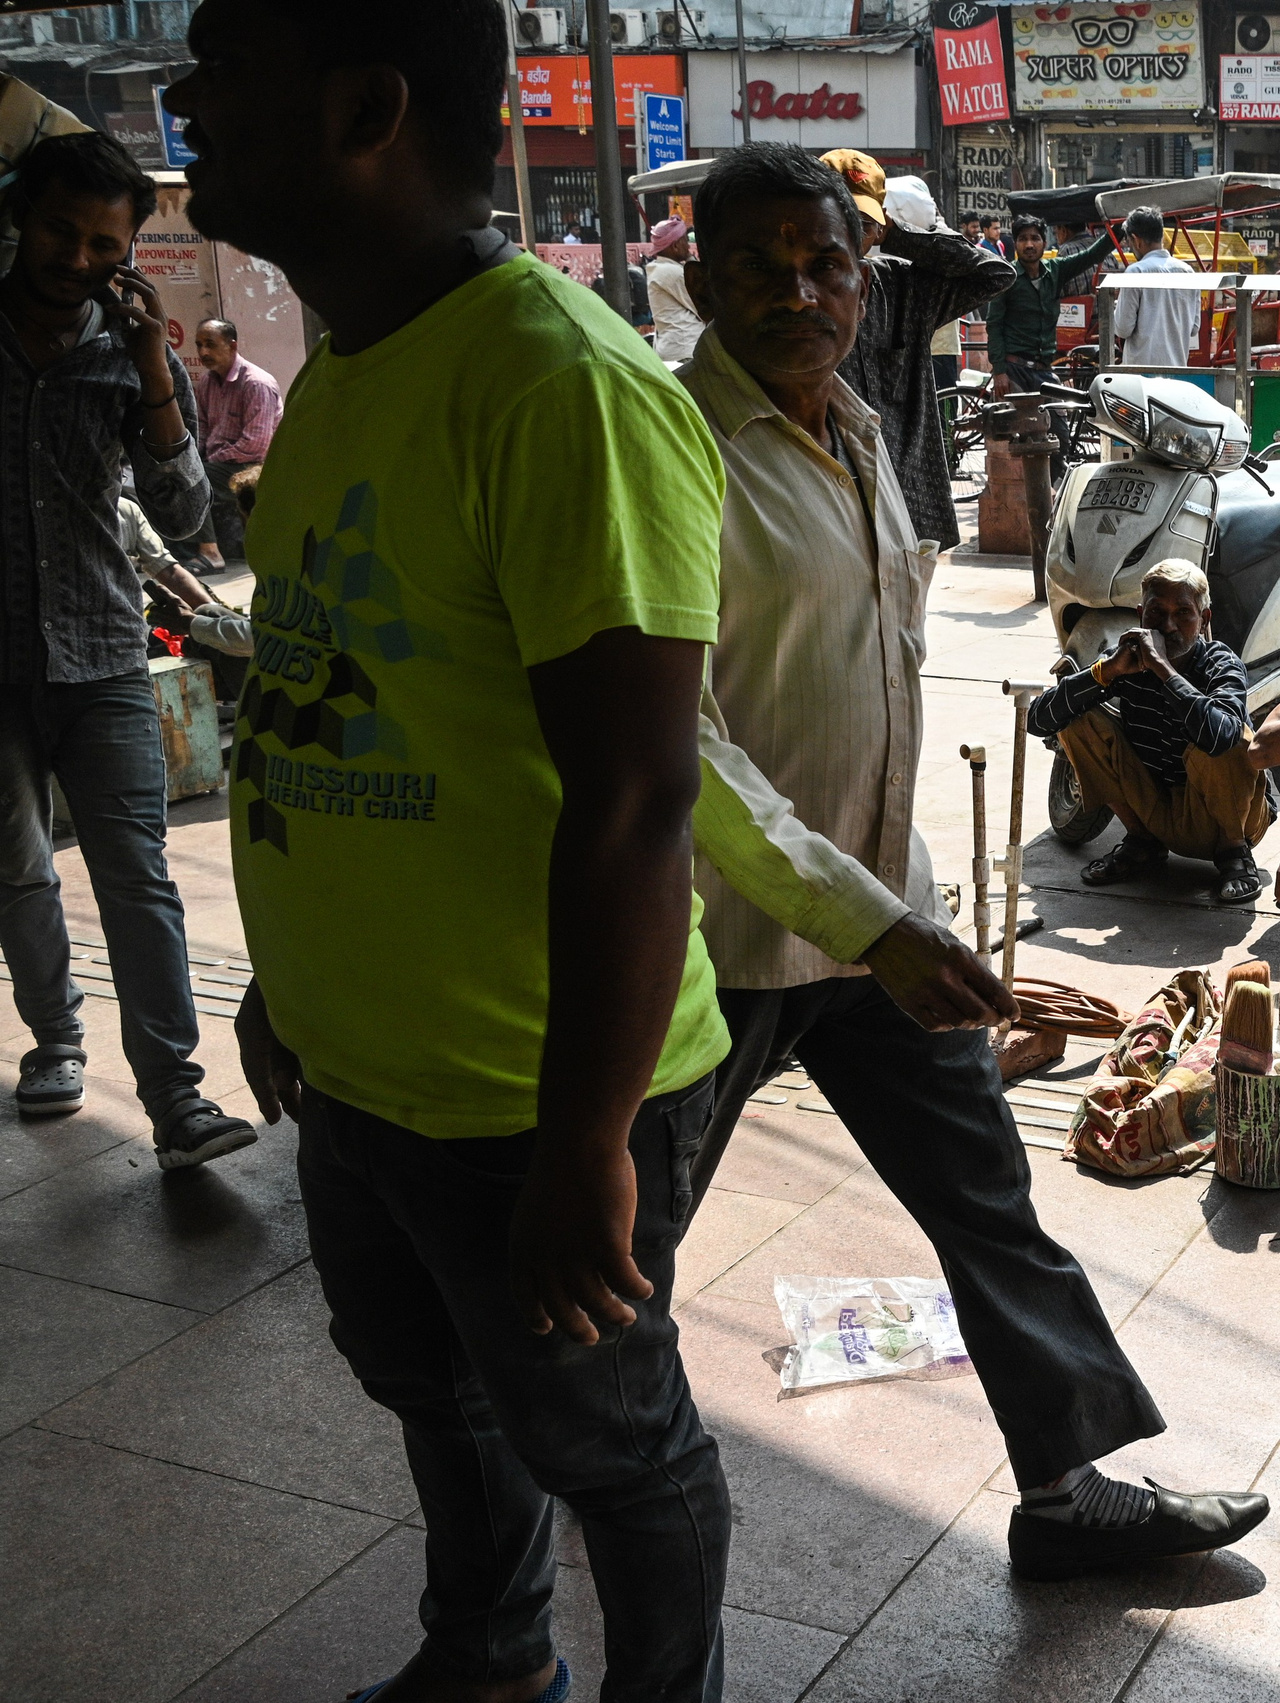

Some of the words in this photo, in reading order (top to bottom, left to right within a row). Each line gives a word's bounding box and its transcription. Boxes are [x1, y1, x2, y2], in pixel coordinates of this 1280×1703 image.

[943, 38, 994, 71] RAMA
[1027, 55, 1095, 80] SUPER
[1104, 54, 1187, 79] OPTICS
[521, 89, 552, 105] Baroda
[731, 79, 866, 120] Bata
[942, 82, 1005, 117] WATCH
[1222, 108, 1240, 119] 297
[649, 119, 680, 133] Welcome
[648, 133, 665, 145] PWD
[665, 135, 683, 147] Limit
[654, 148, 676, 160] Starts
[962, 147, 1013, 168] RADO
[959, 168, 1003, 189] LONGIN
[960, 191, 1008, 212] TISSO
[1242, 229, 1275, 239] RADO
[1108, 467, 1145, 476] HONDA
[266, 753, 436, 800] MISSOURI
[265, 783, 354, 817] HEALTH
[363, 798, 437, 822] CARE
